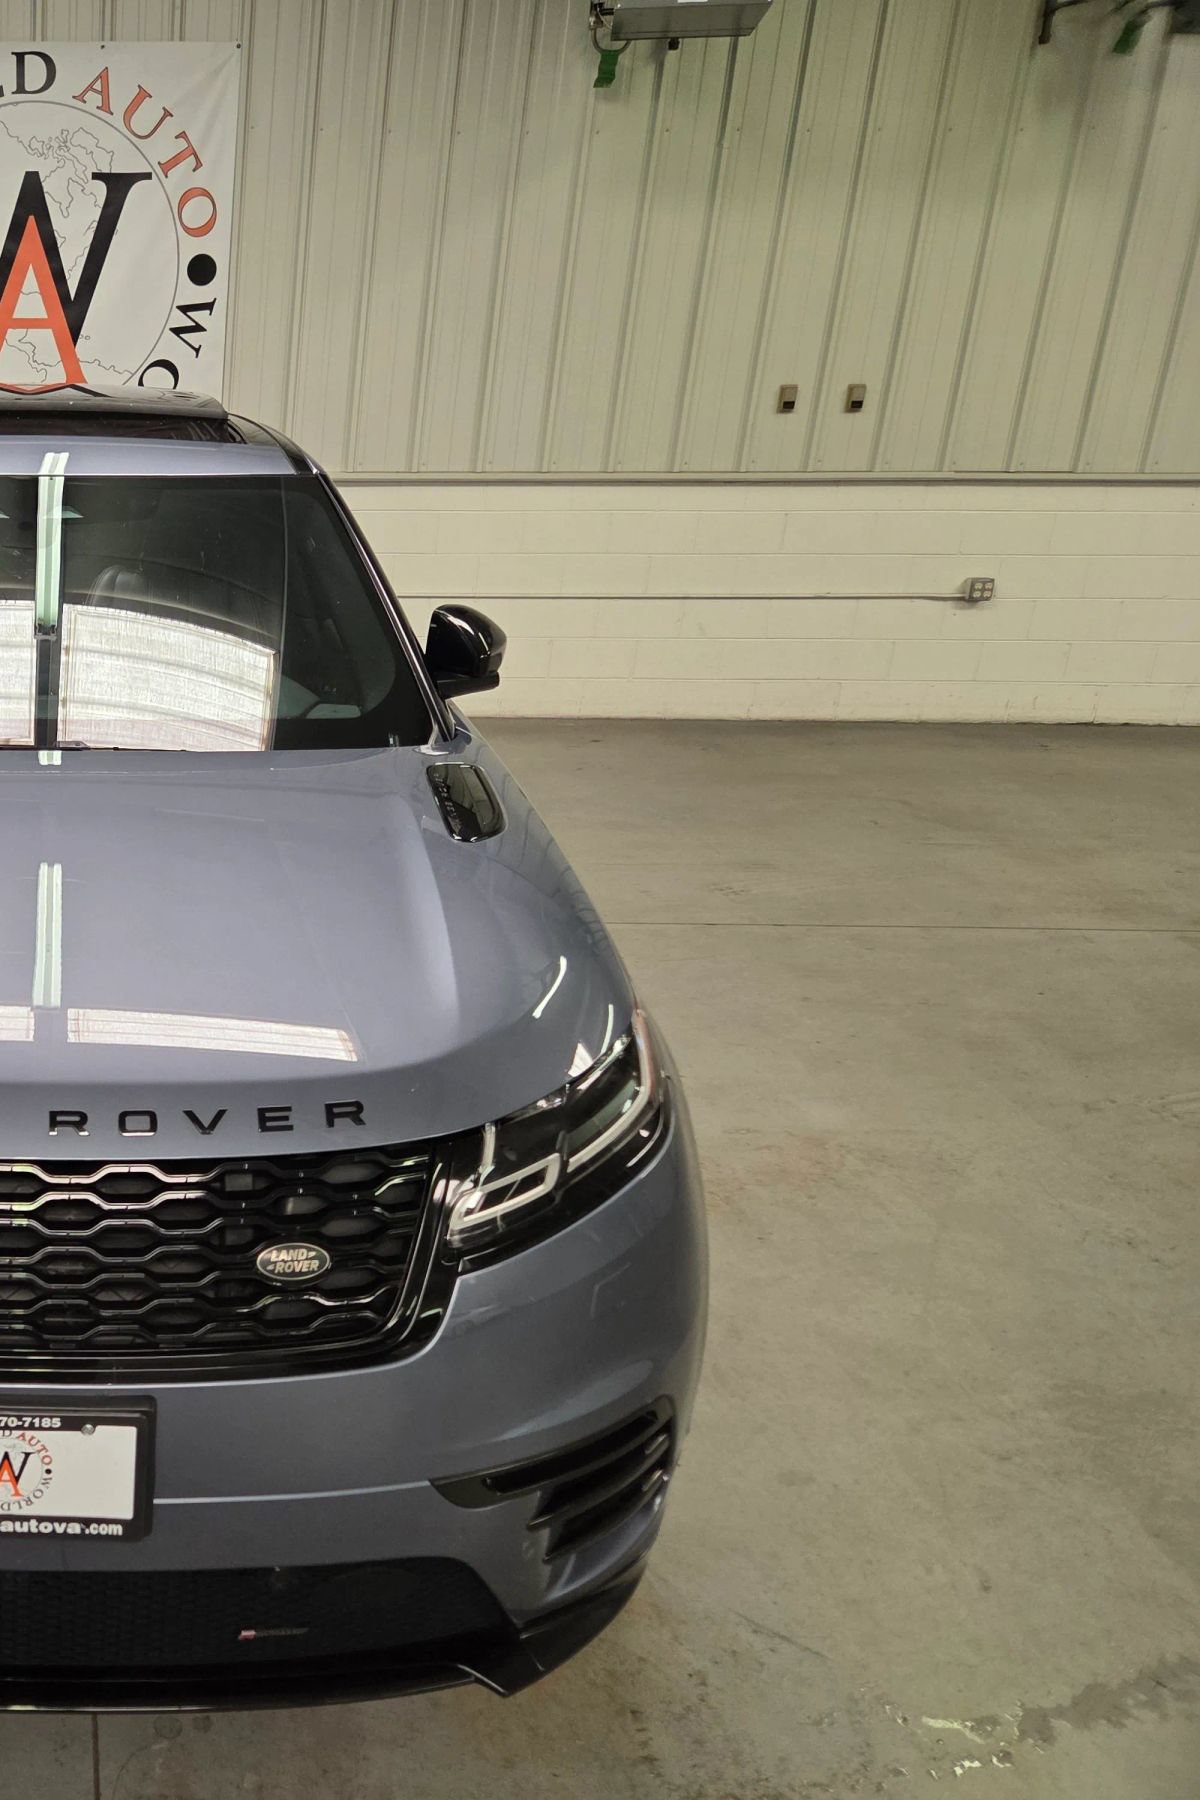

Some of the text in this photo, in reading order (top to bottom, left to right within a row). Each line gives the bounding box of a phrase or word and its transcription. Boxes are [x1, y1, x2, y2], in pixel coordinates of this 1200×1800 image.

[72, 66, 218, 238] AUTO
[48, 1100, 367, 1136] ROVER
[270, 1248, 307, 1262] LAND
[274, 1260, 320, 1273] ROVER
[16, 1432, 53, 1465] AUTO
[0, 1477, 53, 1511] WORLD
